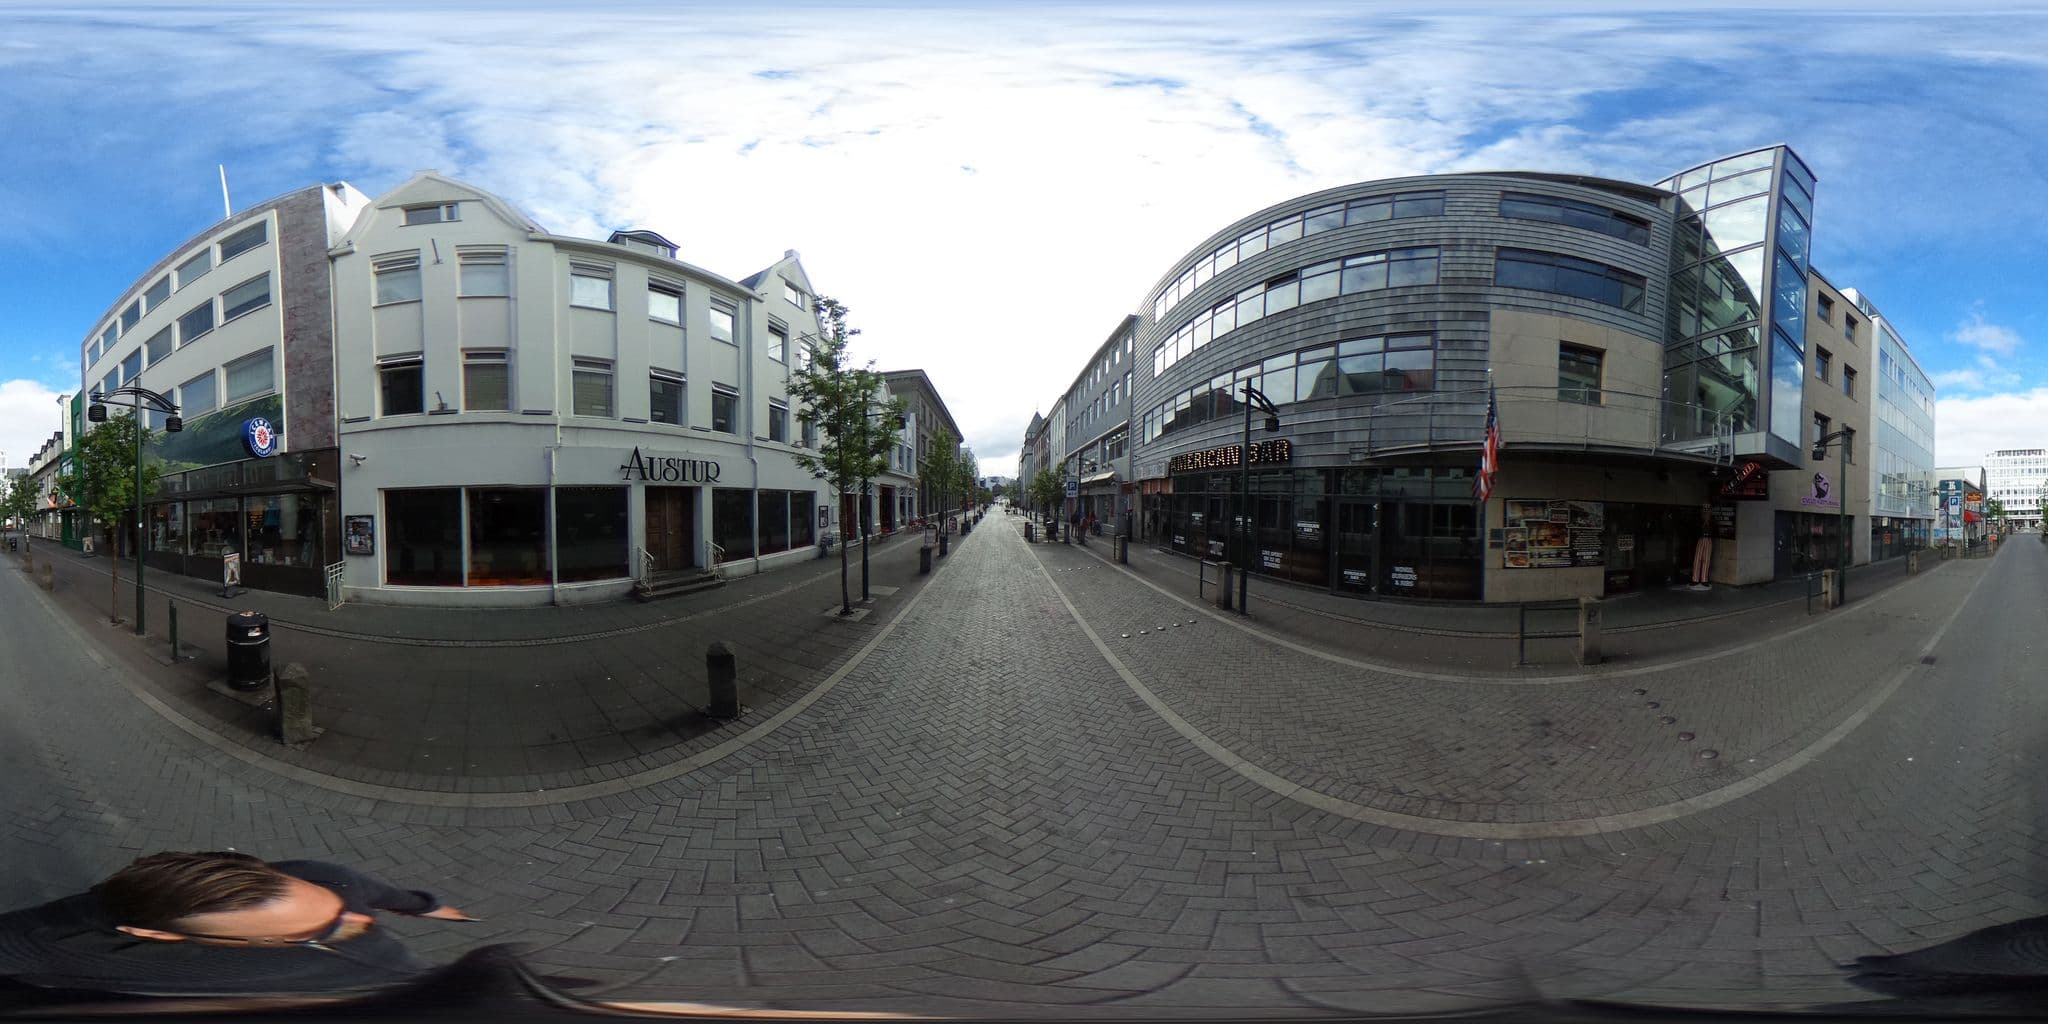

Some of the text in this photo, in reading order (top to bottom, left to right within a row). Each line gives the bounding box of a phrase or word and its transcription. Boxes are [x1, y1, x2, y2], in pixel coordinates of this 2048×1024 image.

[620, 445, 721, 483] AUSTUR
[1170, 445, 1242, 472] AMERICAN
[1248, 439, 1291, 464] BAR
